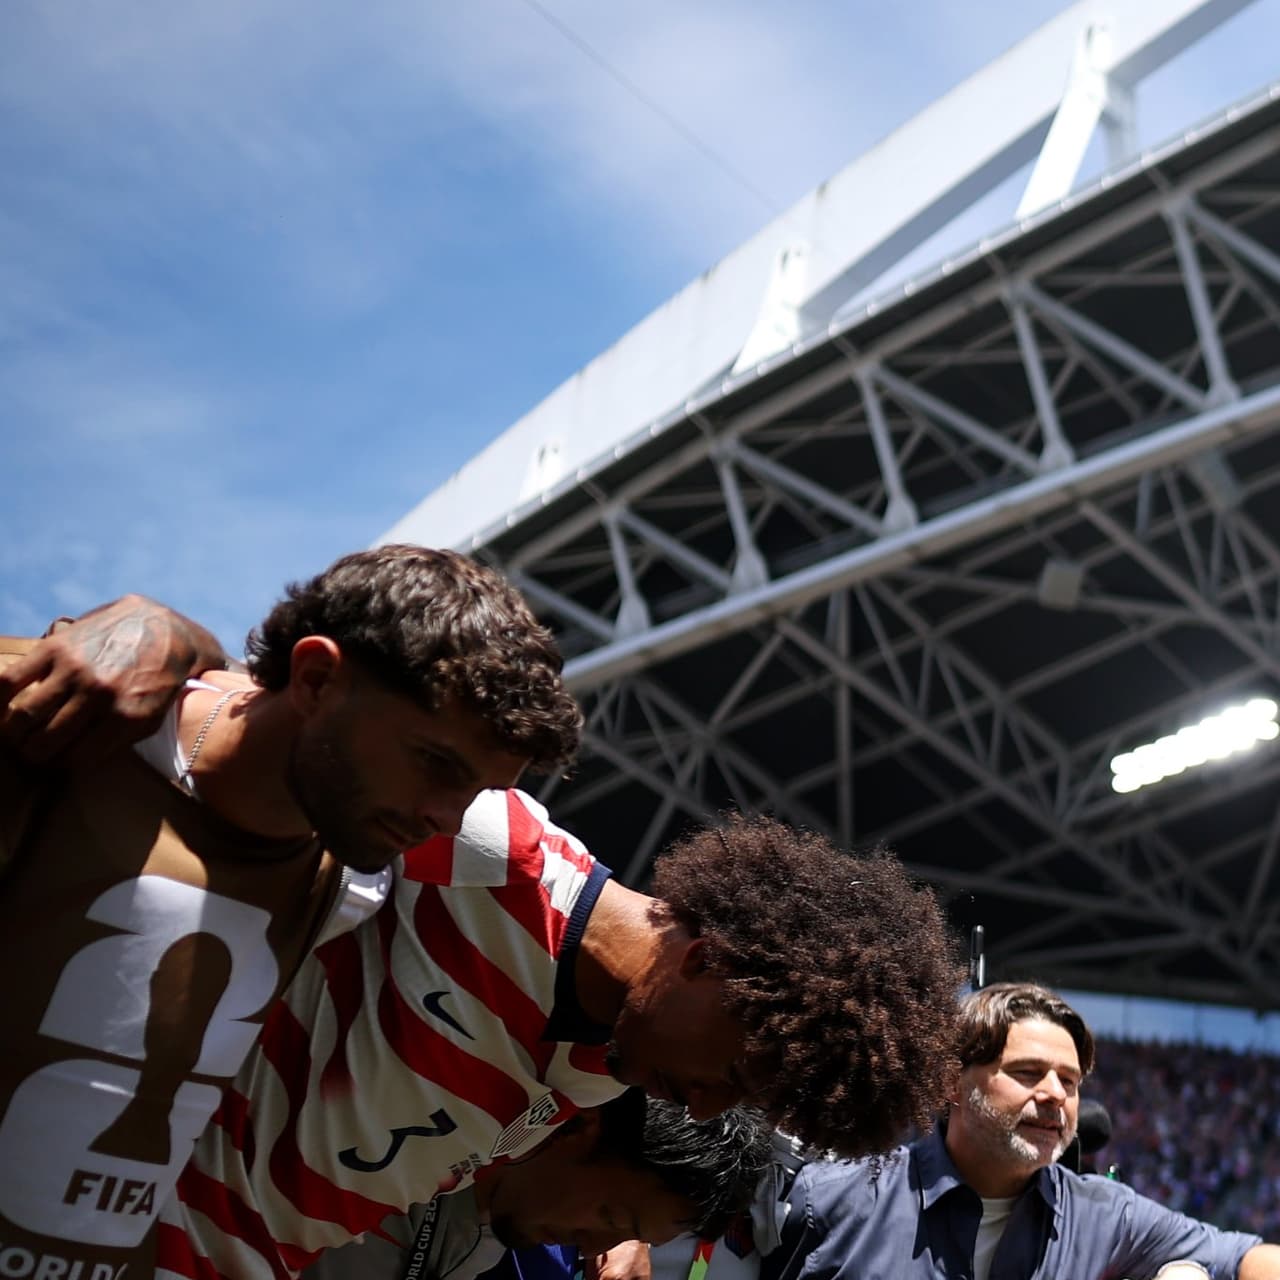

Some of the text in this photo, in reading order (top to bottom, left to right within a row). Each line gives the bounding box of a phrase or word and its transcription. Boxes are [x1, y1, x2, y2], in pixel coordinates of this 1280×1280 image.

[338, 1108, 457, 1173] 3
[63, 1169, 157, 1216] FIFA
[418, 1223, 432, 1250] CUP
